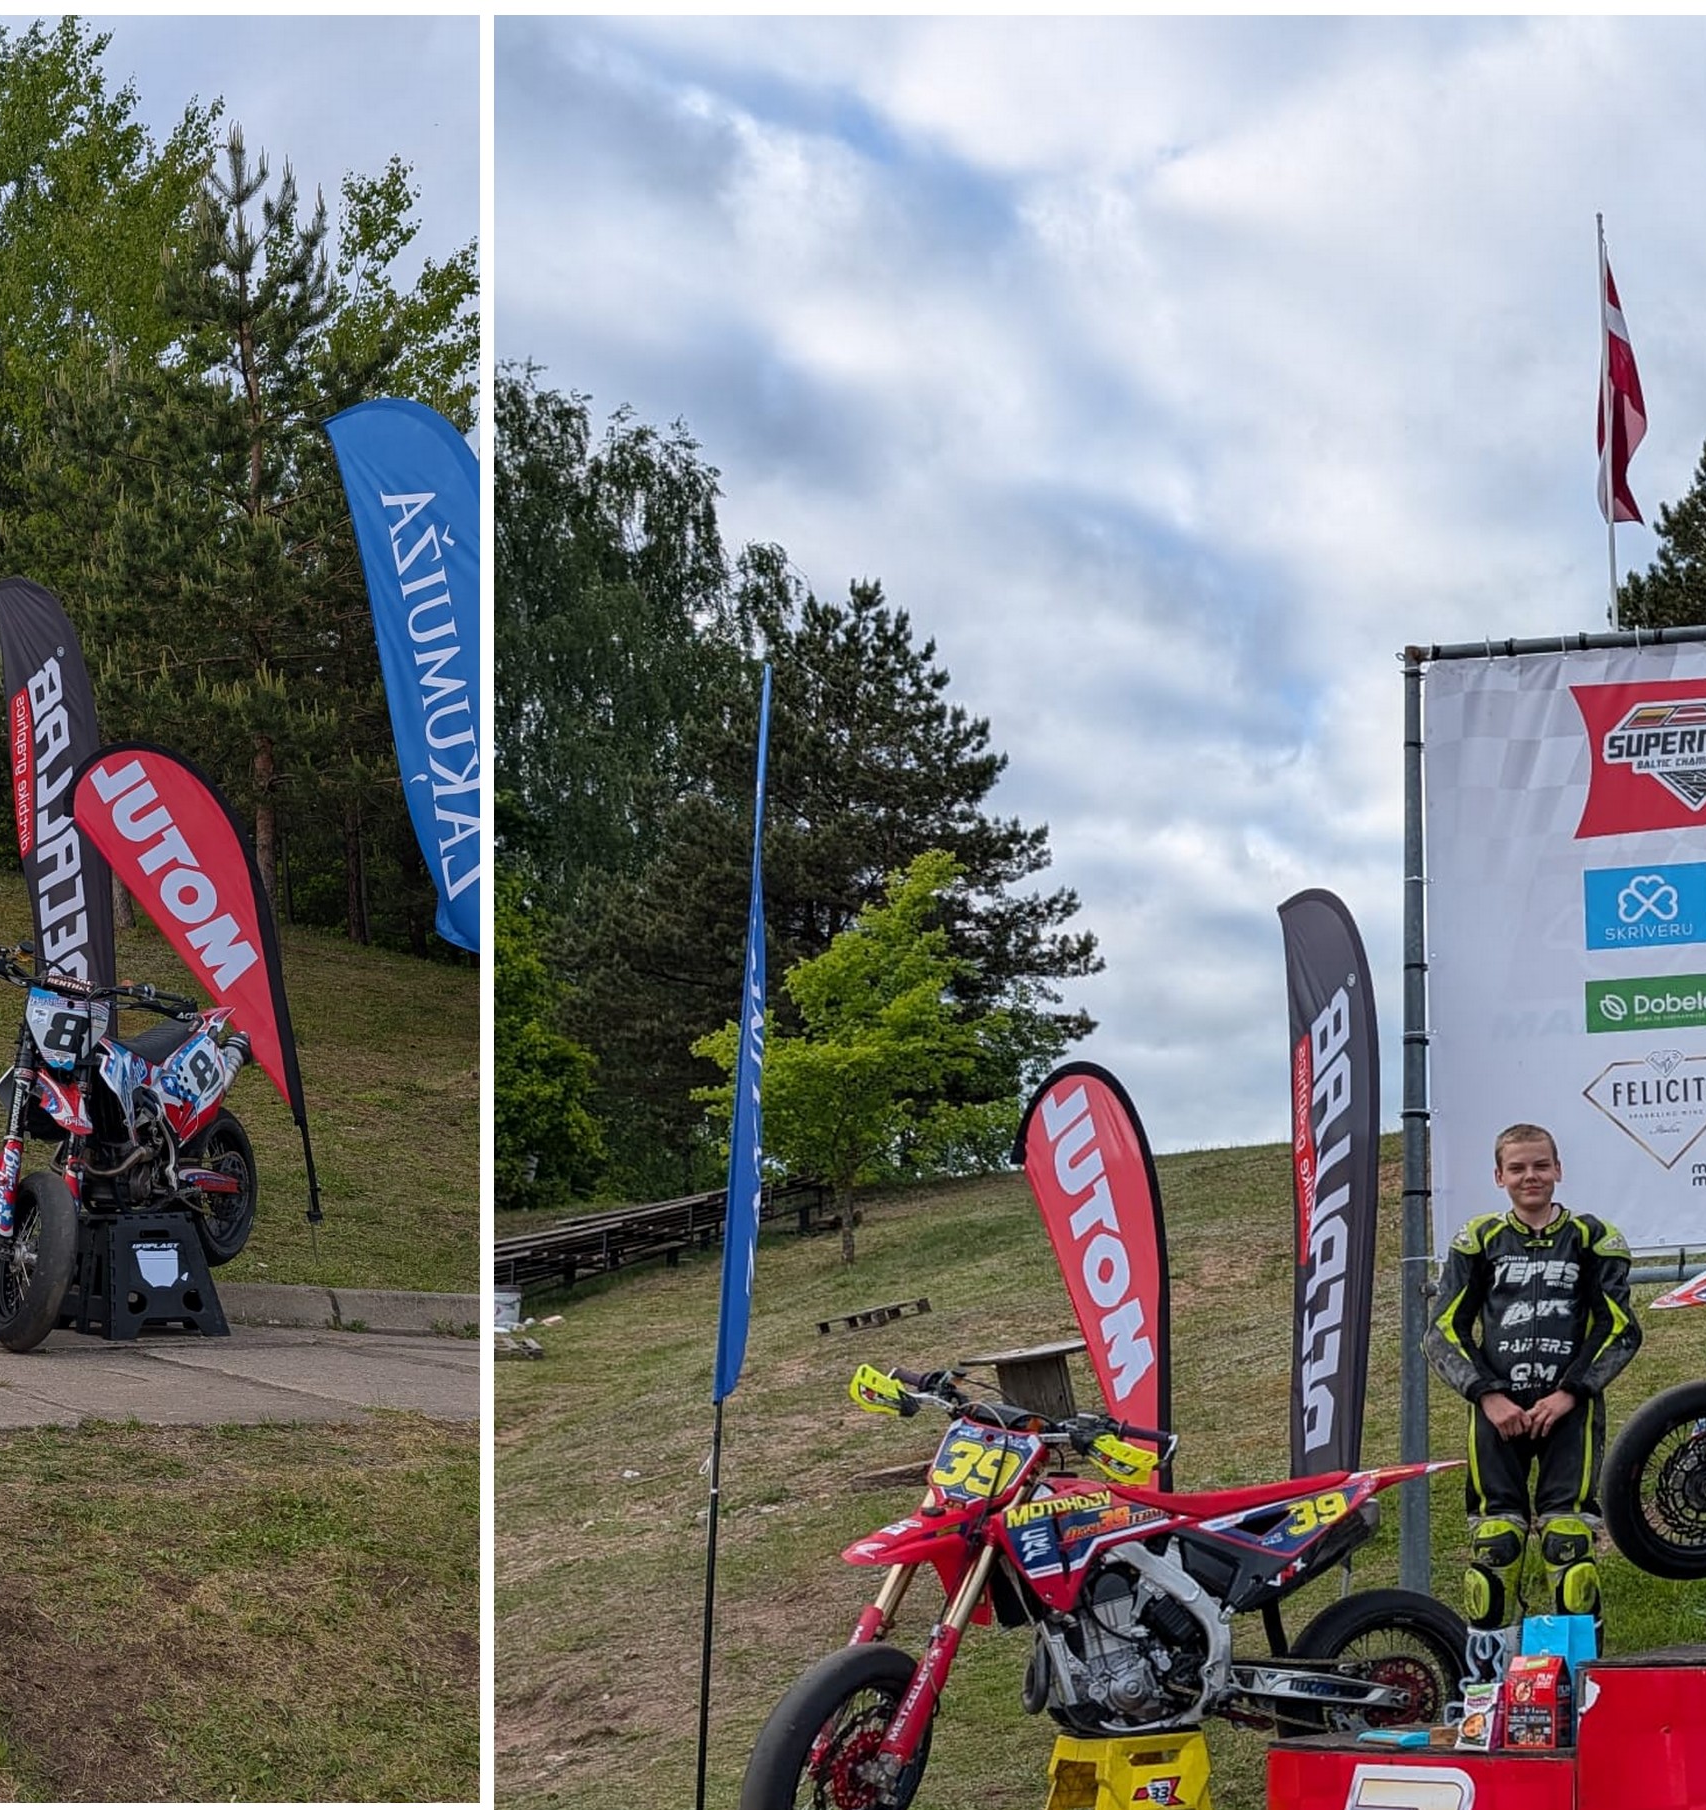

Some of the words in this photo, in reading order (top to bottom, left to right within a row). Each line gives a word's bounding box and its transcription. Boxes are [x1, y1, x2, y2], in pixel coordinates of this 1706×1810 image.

[1637, 757, 1672, 770] BALTIC
[43, 1011, 90, 1056] 8
[189, 1048, 217, 1092] 8
[1493, 1260, 1581, 1289] YEPES
[930, 1440, 1027, 1498] 39
[1287, 1491, 1348, 1538] 39
[1020, 1526, 1053, 1563] CRF
[1149, 1785, 1169, 1798] 33
